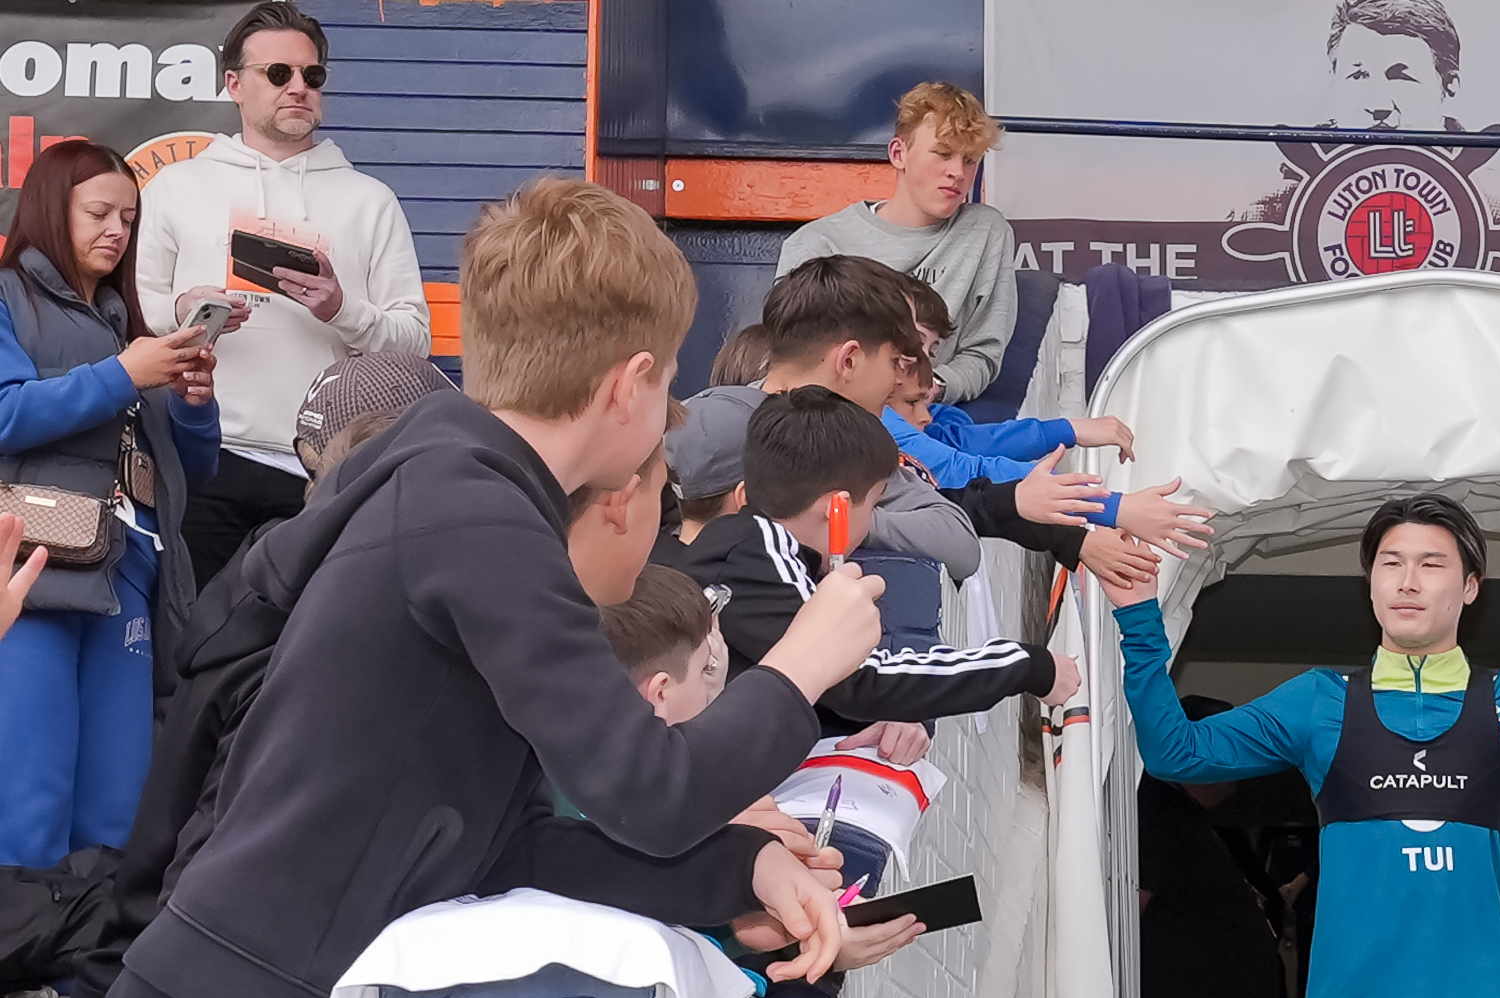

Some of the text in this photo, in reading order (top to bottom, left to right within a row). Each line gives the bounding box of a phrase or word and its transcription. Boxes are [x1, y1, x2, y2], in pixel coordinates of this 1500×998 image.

[0, 40, 236, 102] oma
[133, 140, 213, 180] HATT
[1326, 168, 1451, 222] LUTON TOWN
[1014, 241, 1198, 280] AT THE
[1323, 243, 1361, 278] FO
[1422, 239, 1456, 269] UB
[1369, 774, 1469, 790] CATAPULT
[1401, 846, 1455, 872] TUI
